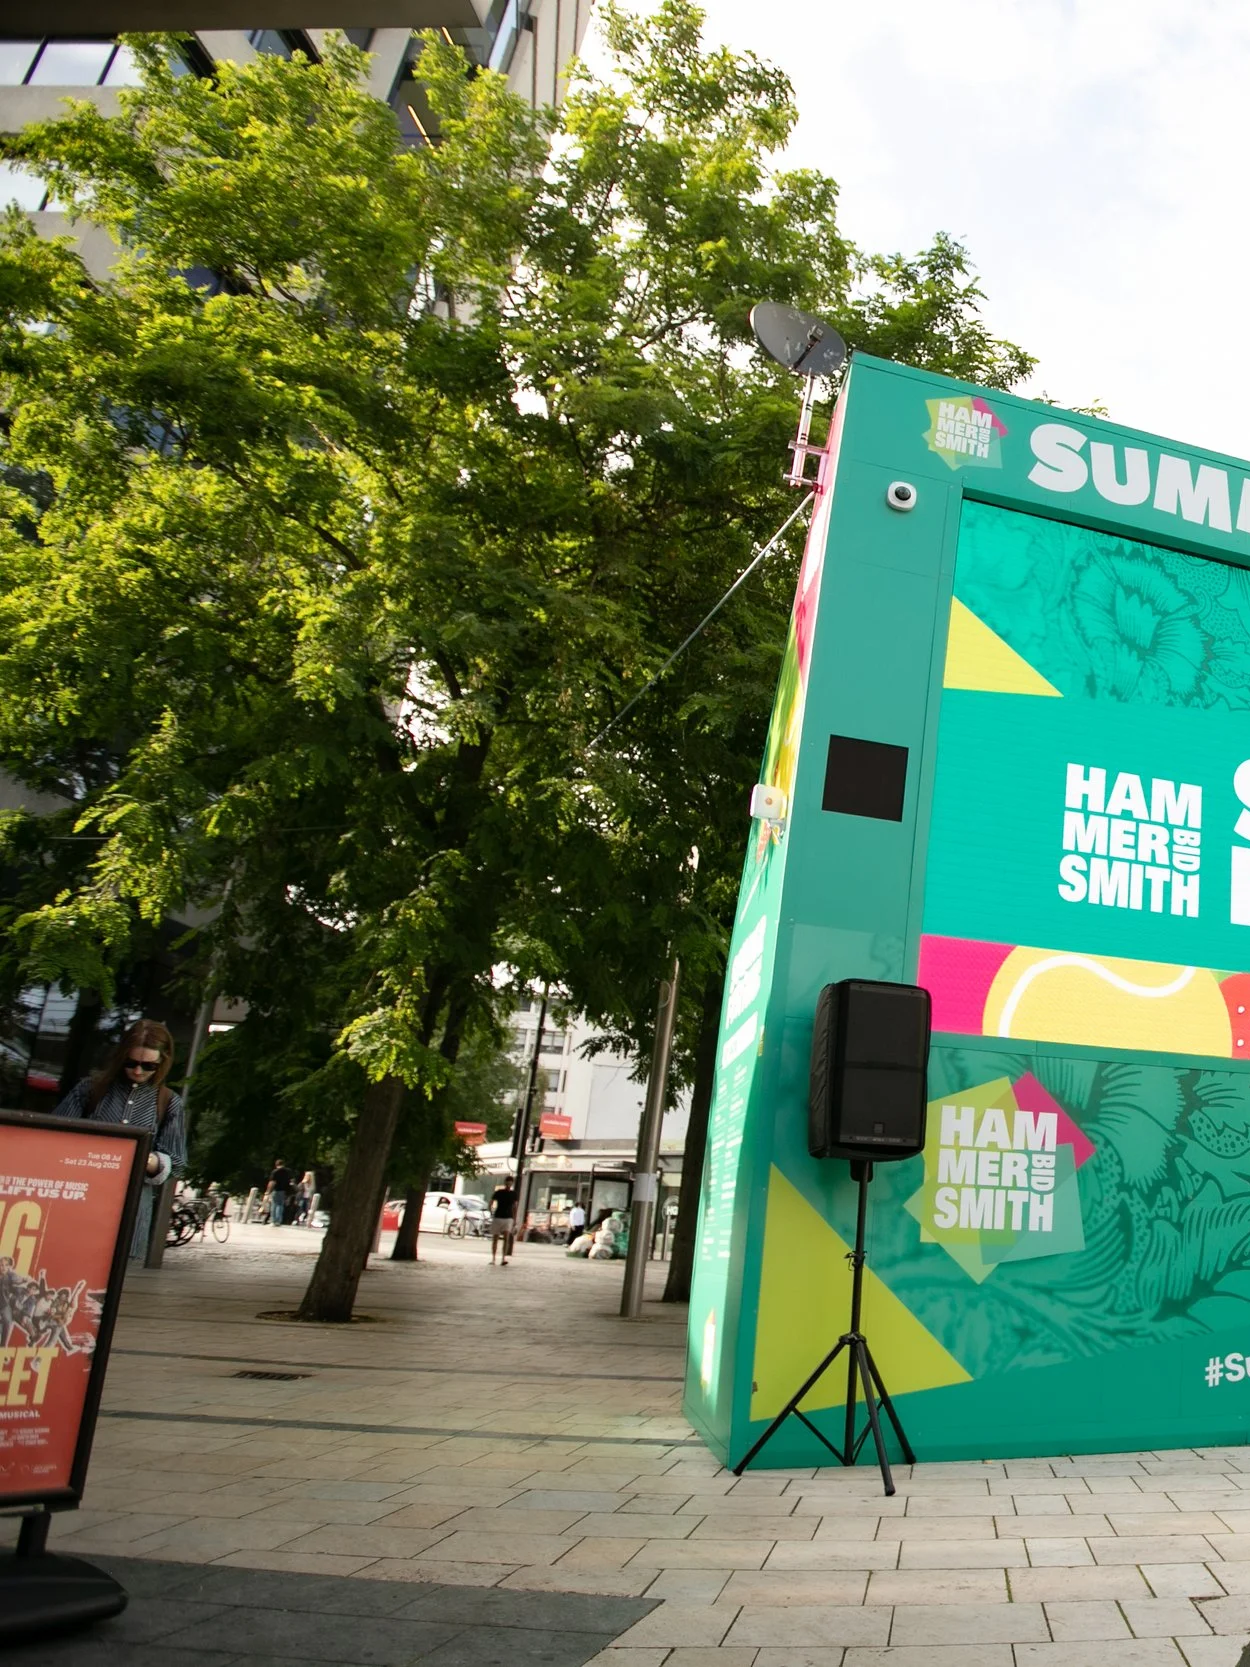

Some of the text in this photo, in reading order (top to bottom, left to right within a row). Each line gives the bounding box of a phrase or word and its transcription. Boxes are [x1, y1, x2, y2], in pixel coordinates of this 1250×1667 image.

[937, 416, 979, 440] MER
[938, 401, 992, 429] HAM
[934, 431, 989, 459] SMITH
[1065, 762, 1203, 829] HAM
[1062, 810, 1170, 866] MER
[1172, 828, 1201, 872] BID
[1057, 853, 1200, 918] SMITH
[940, 1104, 1058, 1152] HAM
[64, 1157, 77, 1166] Sat
[77, 1158, 87, 1166] 23
[87, 1160, 102, 1169] Aug
[102, 1161, 121, 1170] 2025
[88, 1151, 100, 1160] Tue
[112, 1154, 122, 1162] Jul
[937, 1148, 1029, 1187] MER
[1030, 1153, 1056, 1191] BID
[0, 1184, 87, 1201] LIFT US UP.
[12, 1176, 27, 1186] THE
[27, 1177, 54, 1189] POWER
[54, 1180, 65, 1190] OF
[65, 1181, 89, 1192] MUSIC
[933, 1186, 1054, 1232] SMITH
[0, 1409, 40, 1420] MUSICAL
